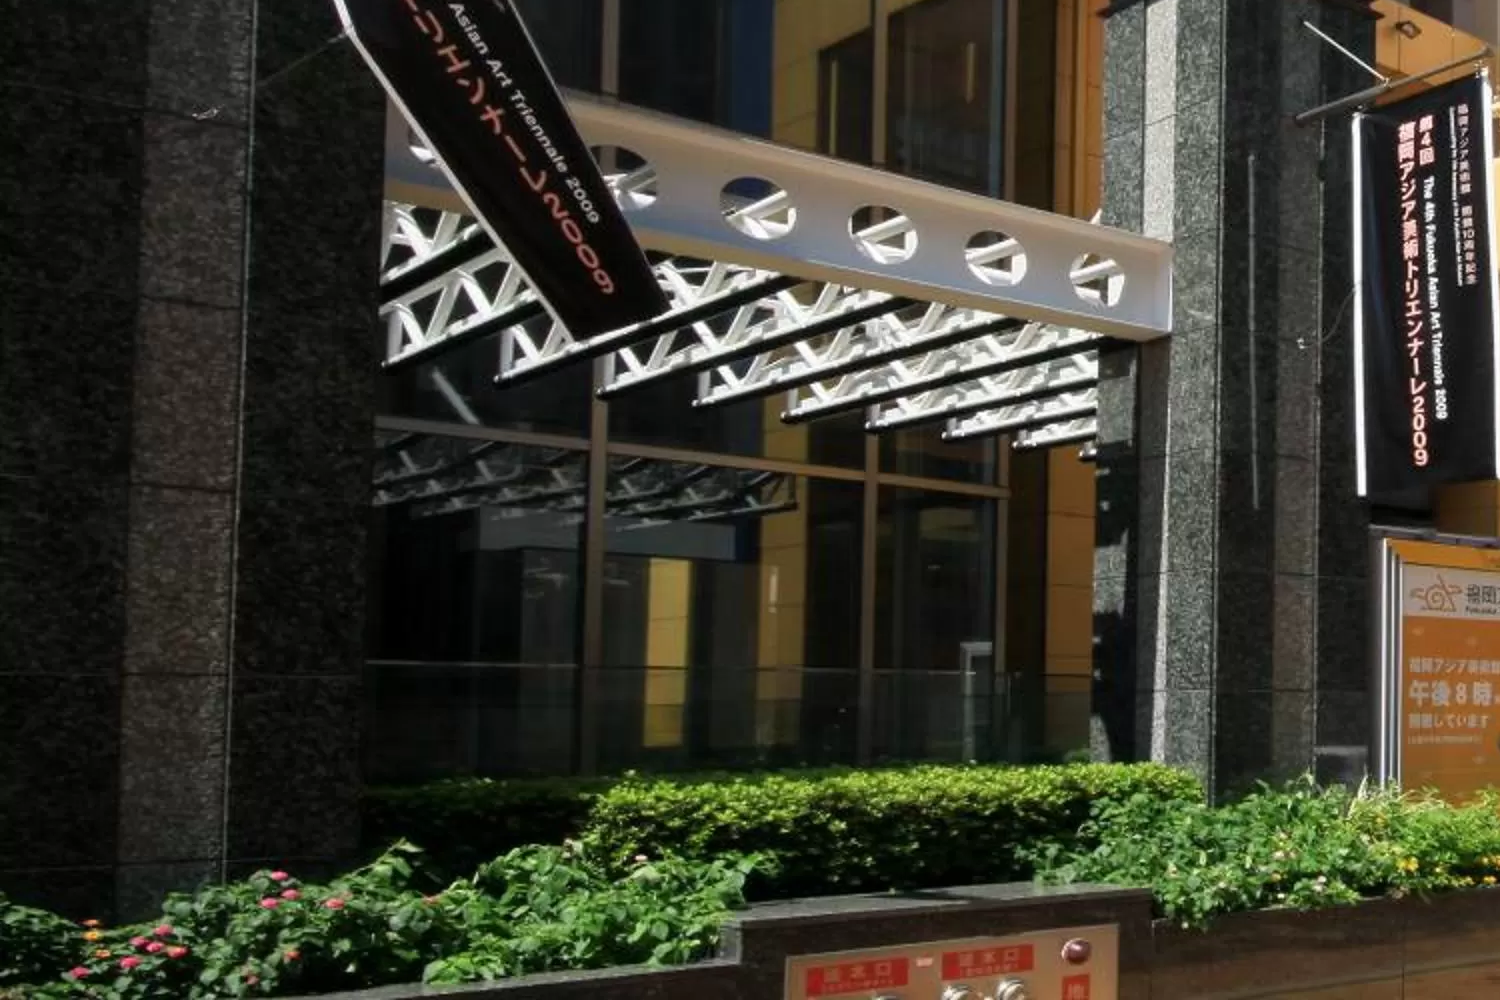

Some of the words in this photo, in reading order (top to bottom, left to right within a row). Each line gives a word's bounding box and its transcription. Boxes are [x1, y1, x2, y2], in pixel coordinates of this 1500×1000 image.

[448, 2, 489, 56] Asian
[486, 58, 512, 88] Art
[511, 89, 568, 174] Triennale
[565, 175, 600, 224] 2009
[1423, 175, 1435, 200] The
[1424, 201, 1436, 223] 4th
[1425, 223, 1438, 275] Fukuoka
[1428, 276, 1440, 309] Asian
[1429, 311, 1441, 330] Art
[1432, 331, 1445, 386] Triennale
[1435, 388, 1449, 420] 2009
